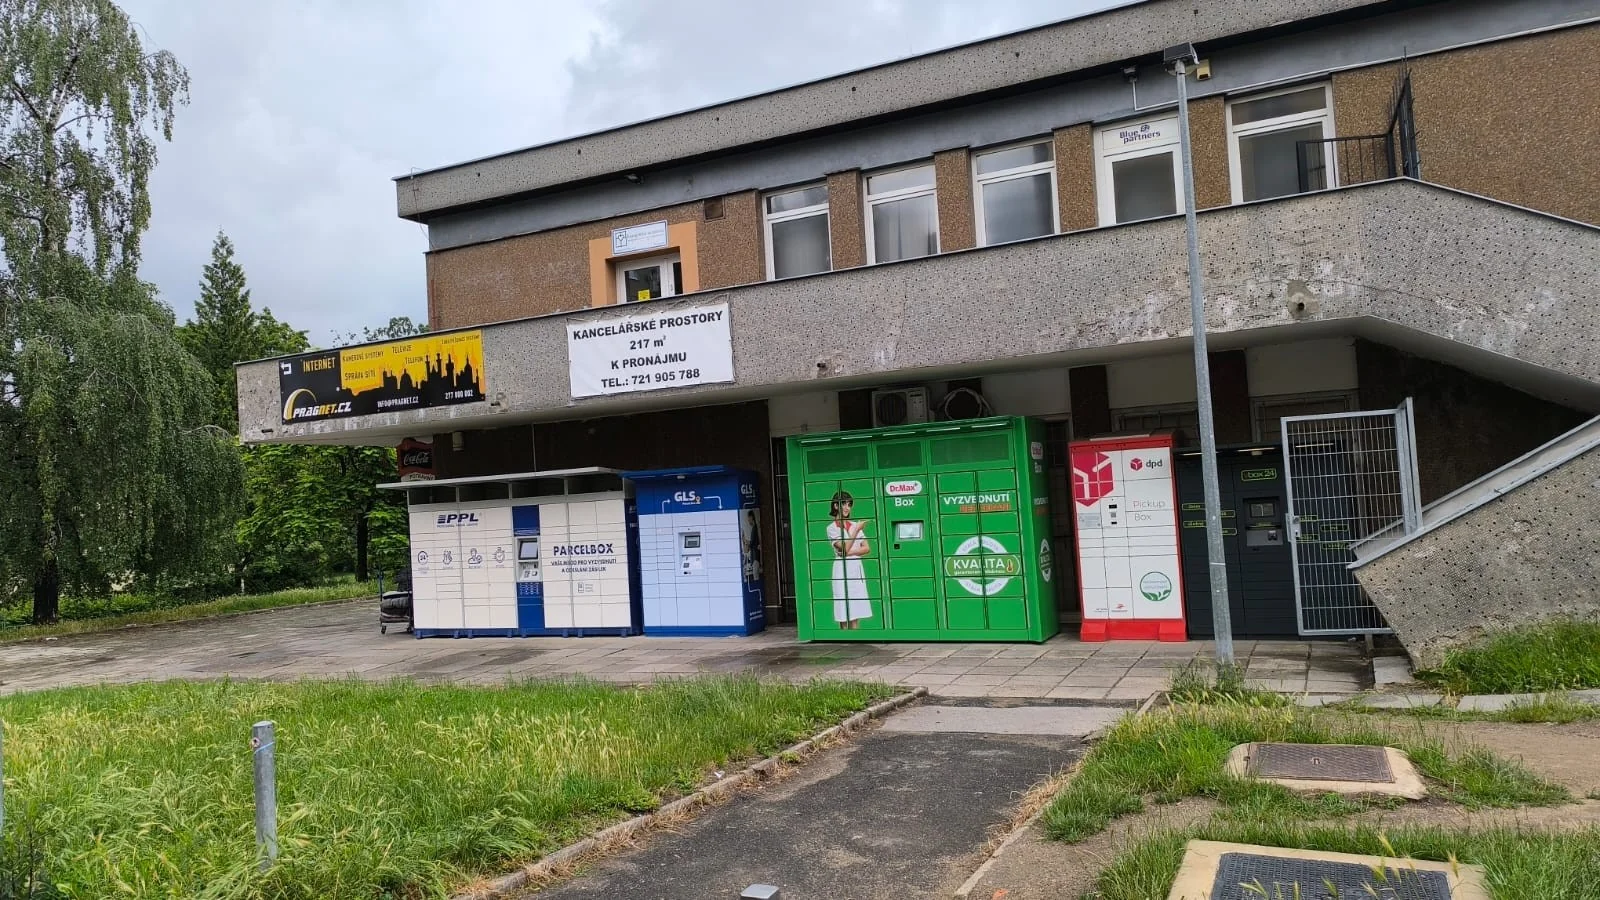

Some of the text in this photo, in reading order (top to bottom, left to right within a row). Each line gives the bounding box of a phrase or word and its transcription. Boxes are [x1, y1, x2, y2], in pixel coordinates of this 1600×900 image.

[1120, 130, 1139, 138] Blue
[1124, 130, 1161, 144] partners
[573, 310, 723, 340] KANCELÁŘSKÉ PROSTORY
[630, 339, 649, 350] 217
[303, 357, 336, 372] INTERNET
[611, 352, 687, 370] K PRONÁJMU
[601, 368, 700, 388] TEL.: 721 905 788
[1145, 459, 1163, 469] dpd
[740, 484, 753, 494] GLS
[674, 491, 696, 502] GLS
[895, 497, 915, 506] Box
[943, 491, 1010, 505] VYZVEDNUTÍ
[1132, 500, 1166, 509] Pickup
[446, 513, 479, 523] PPL
[1135, 513, 1151, 521] Box
[553, 543, 614, 556] PARCELBOX
